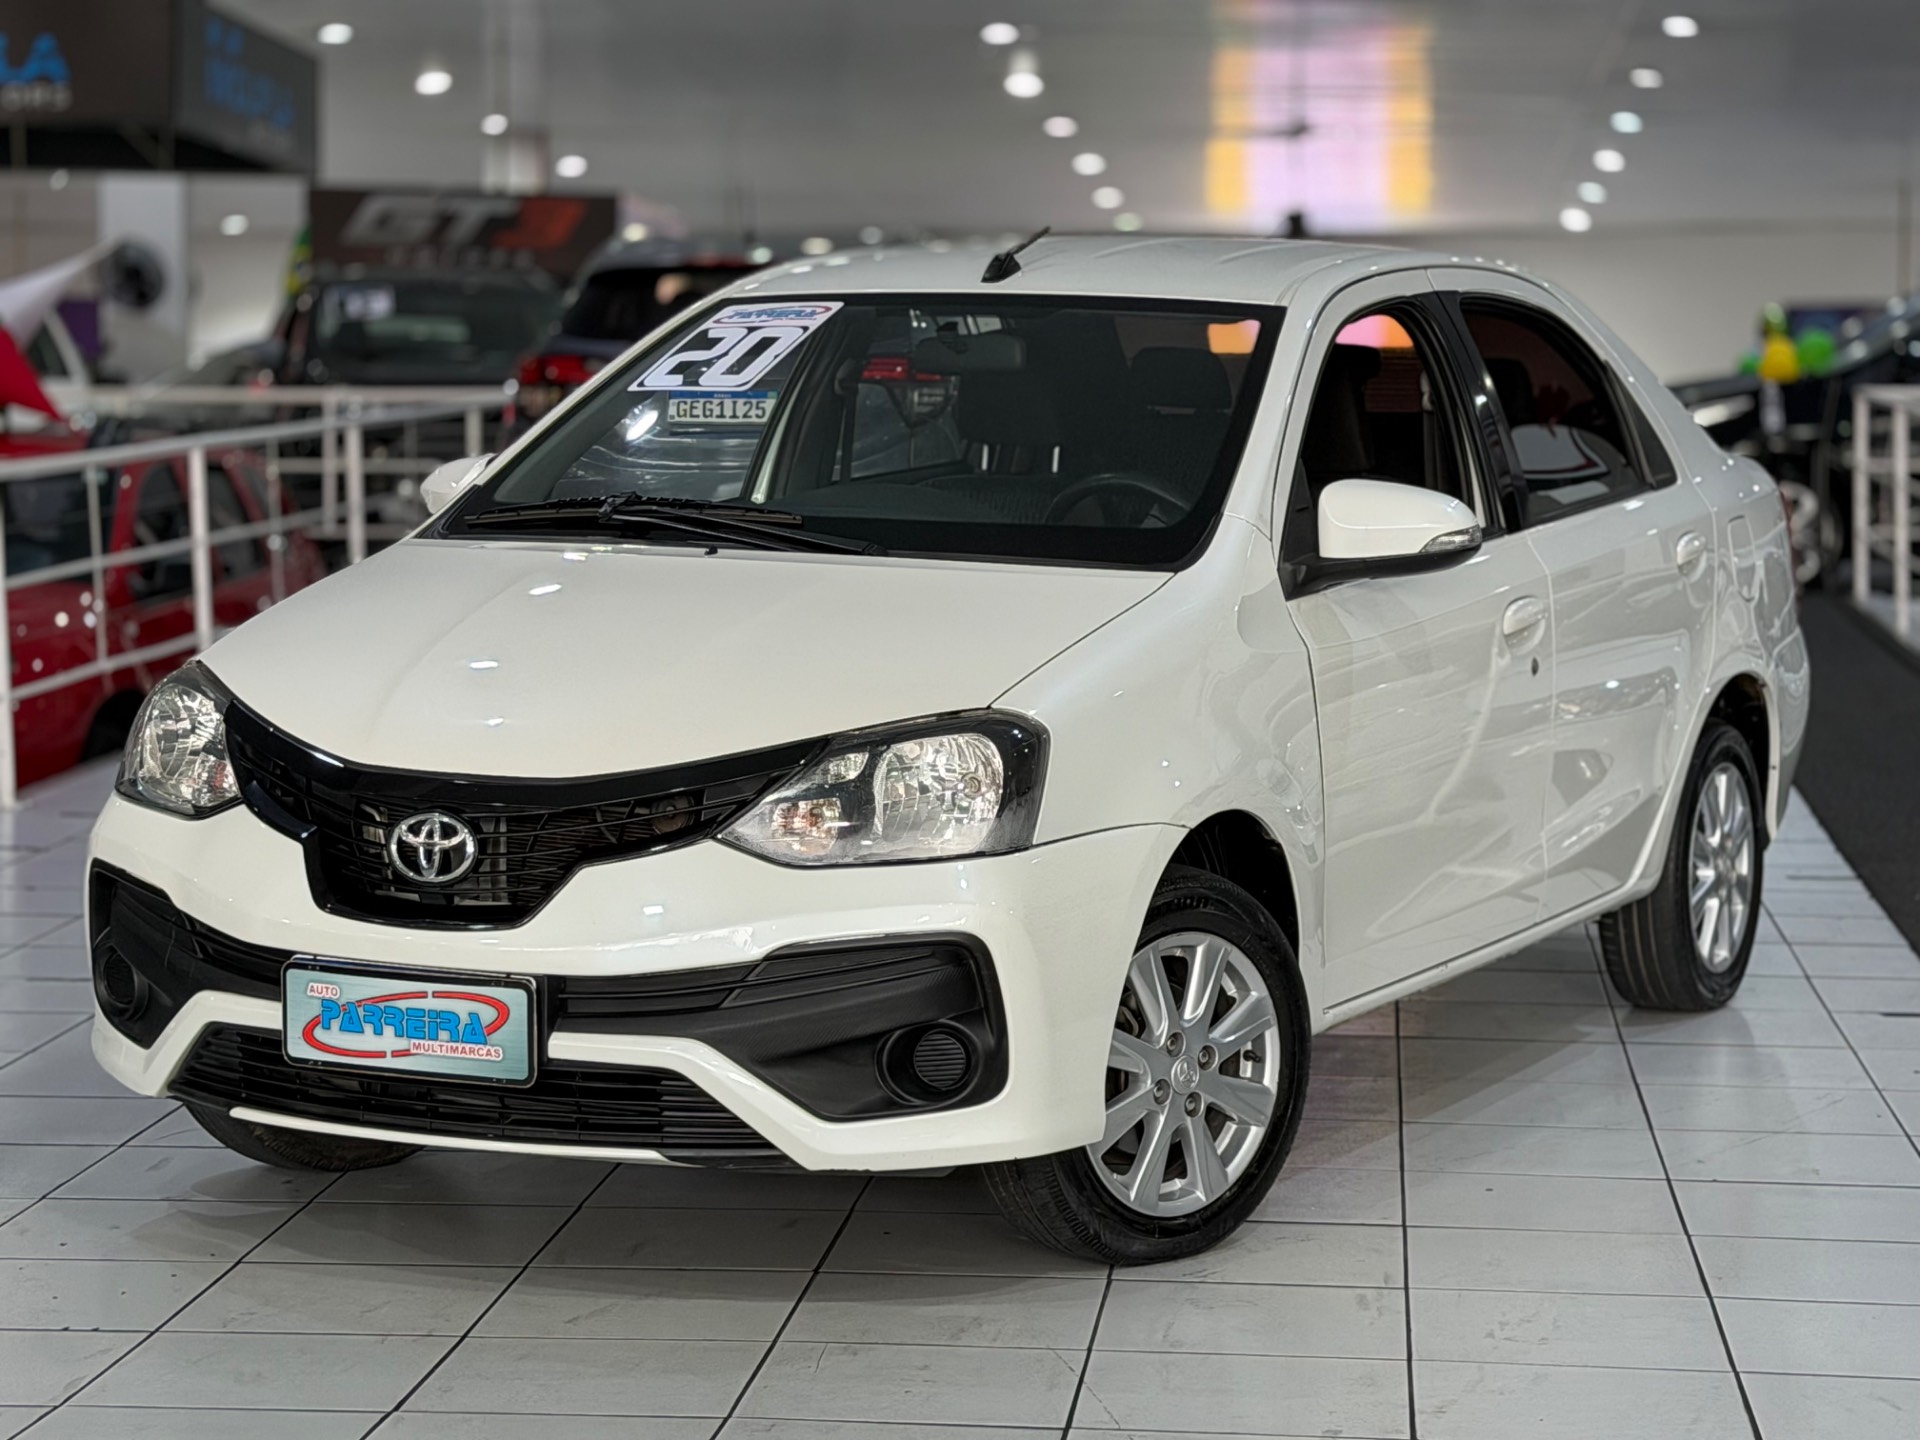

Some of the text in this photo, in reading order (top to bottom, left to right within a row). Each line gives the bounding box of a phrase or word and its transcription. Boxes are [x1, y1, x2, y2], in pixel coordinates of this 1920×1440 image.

[643, 327, 804, 387] 20
[676, 400, 767, 420] GEG1I25
[308, 984, 339, 997] AUTO
[320, 999, 488, 1045] PARREIRA
[411, 1041, 502, 1059] MULTIMARCAS
